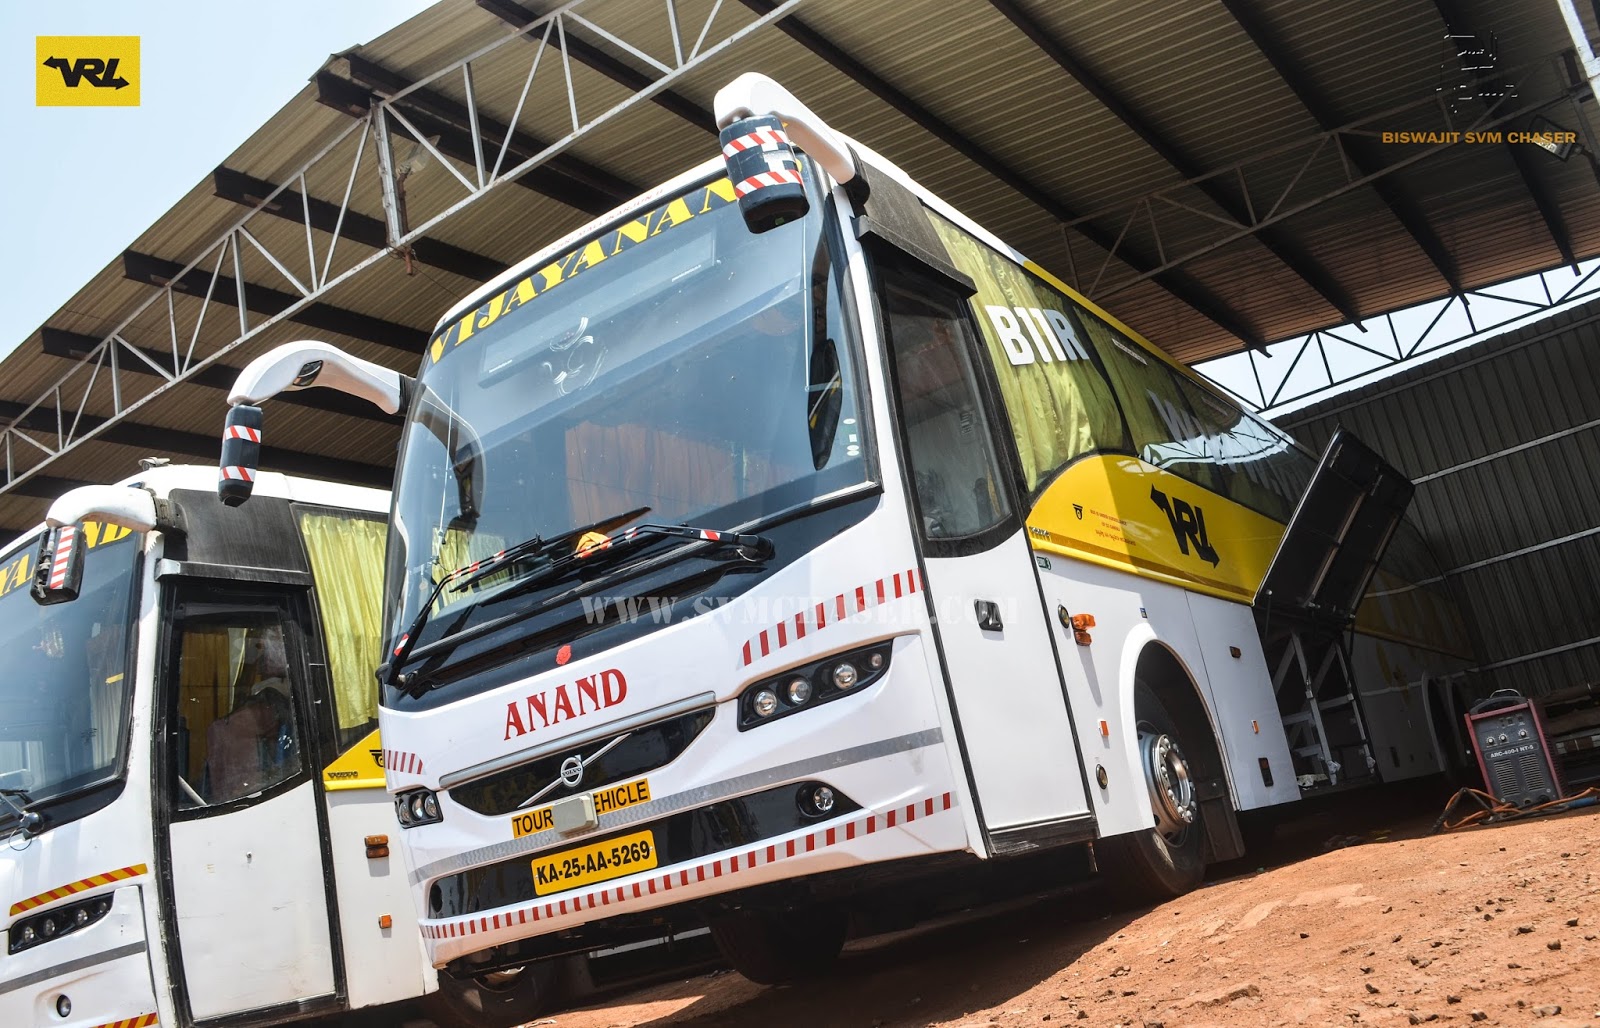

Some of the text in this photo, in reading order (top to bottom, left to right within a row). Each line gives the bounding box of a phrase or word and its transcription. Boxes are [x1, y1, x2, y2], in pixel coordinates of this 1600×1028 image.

[430, 158, 802, 365] VIJAYANAN
[984, 304, 1090, 366] B11R
[1150, 483, 1220, 569] VRL
[503, 668, 628, 741] ANAND
[562, 767, 582, 777] VOLVO
[513, 781, 649, 836] TOUR EHICLE
[536, 839, 651, 885] KA-25-AA-5269
